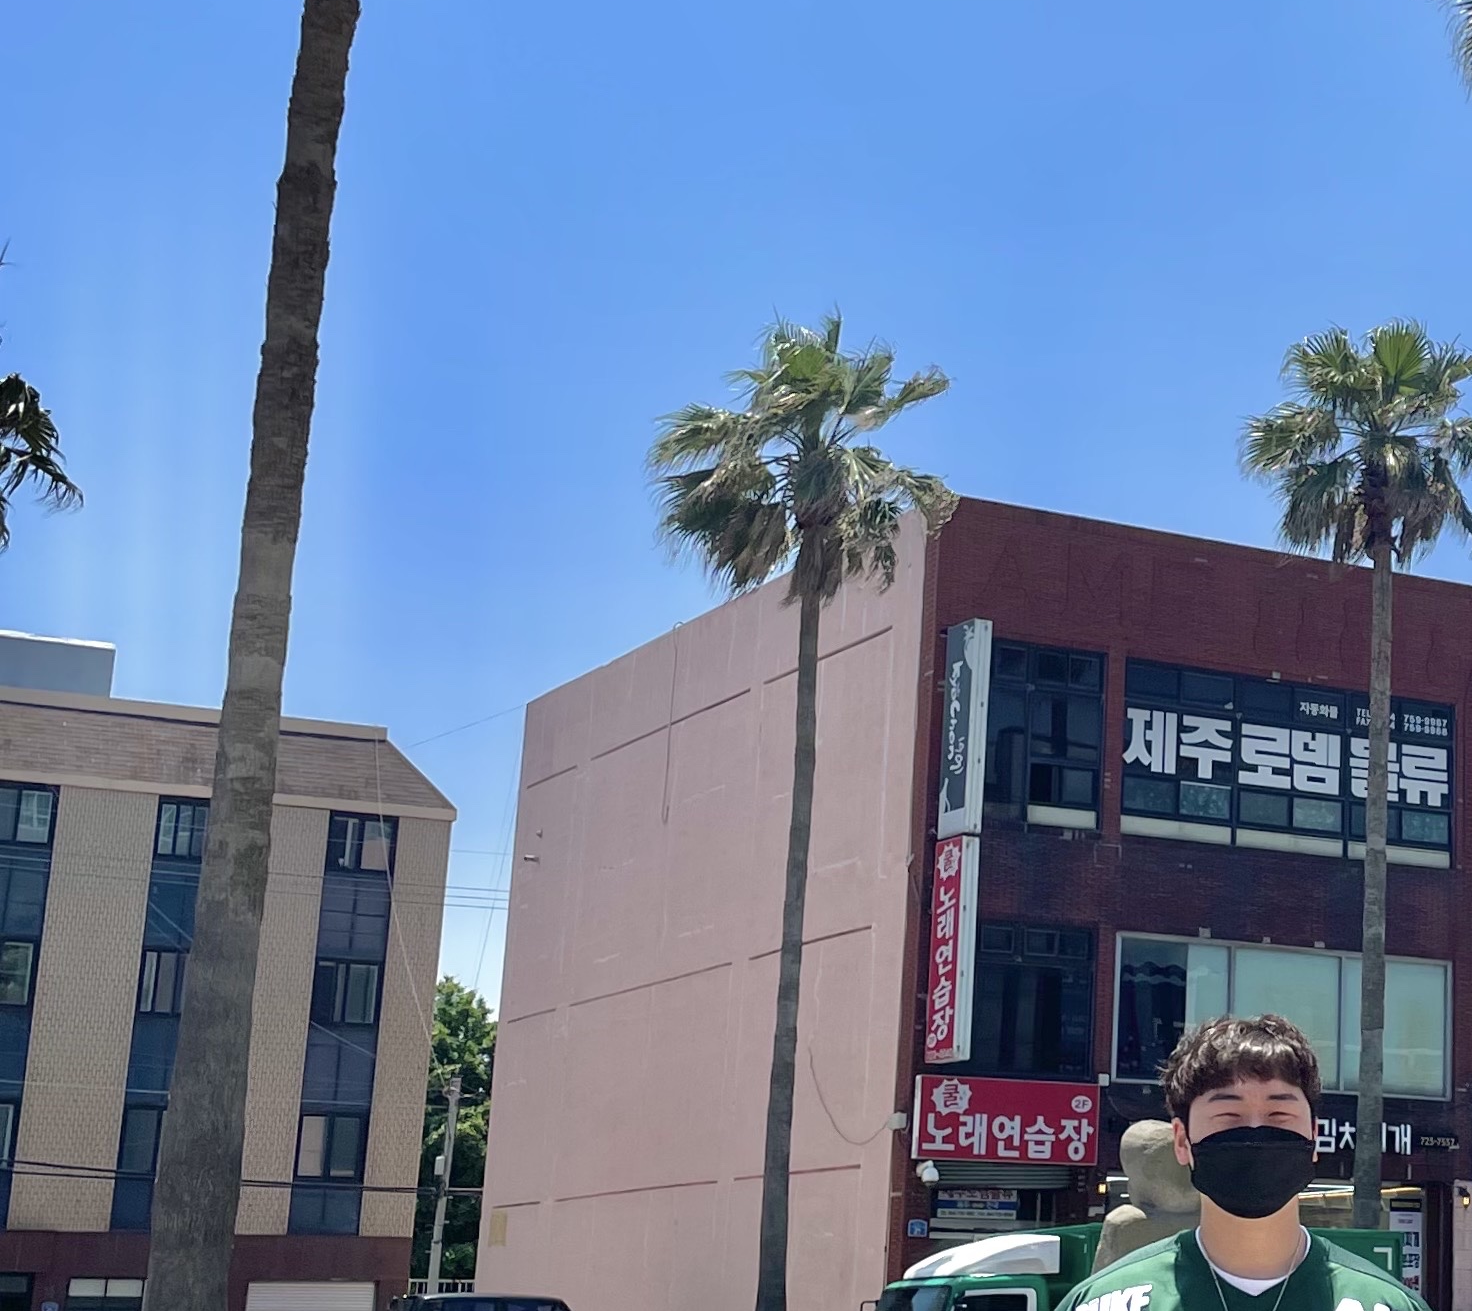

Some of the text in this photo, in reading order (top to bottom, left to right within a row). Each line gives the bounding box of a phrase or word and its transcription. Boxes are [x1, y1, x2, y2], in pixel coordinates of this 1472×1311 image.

[1299, 701, 1339, 720] 자동화물
[931, 885, 957, 1042] 노래연습장
[1073, 1099, 1090, 1109] 2F
[921, 1112, 1095, 1162] 노래연습장
